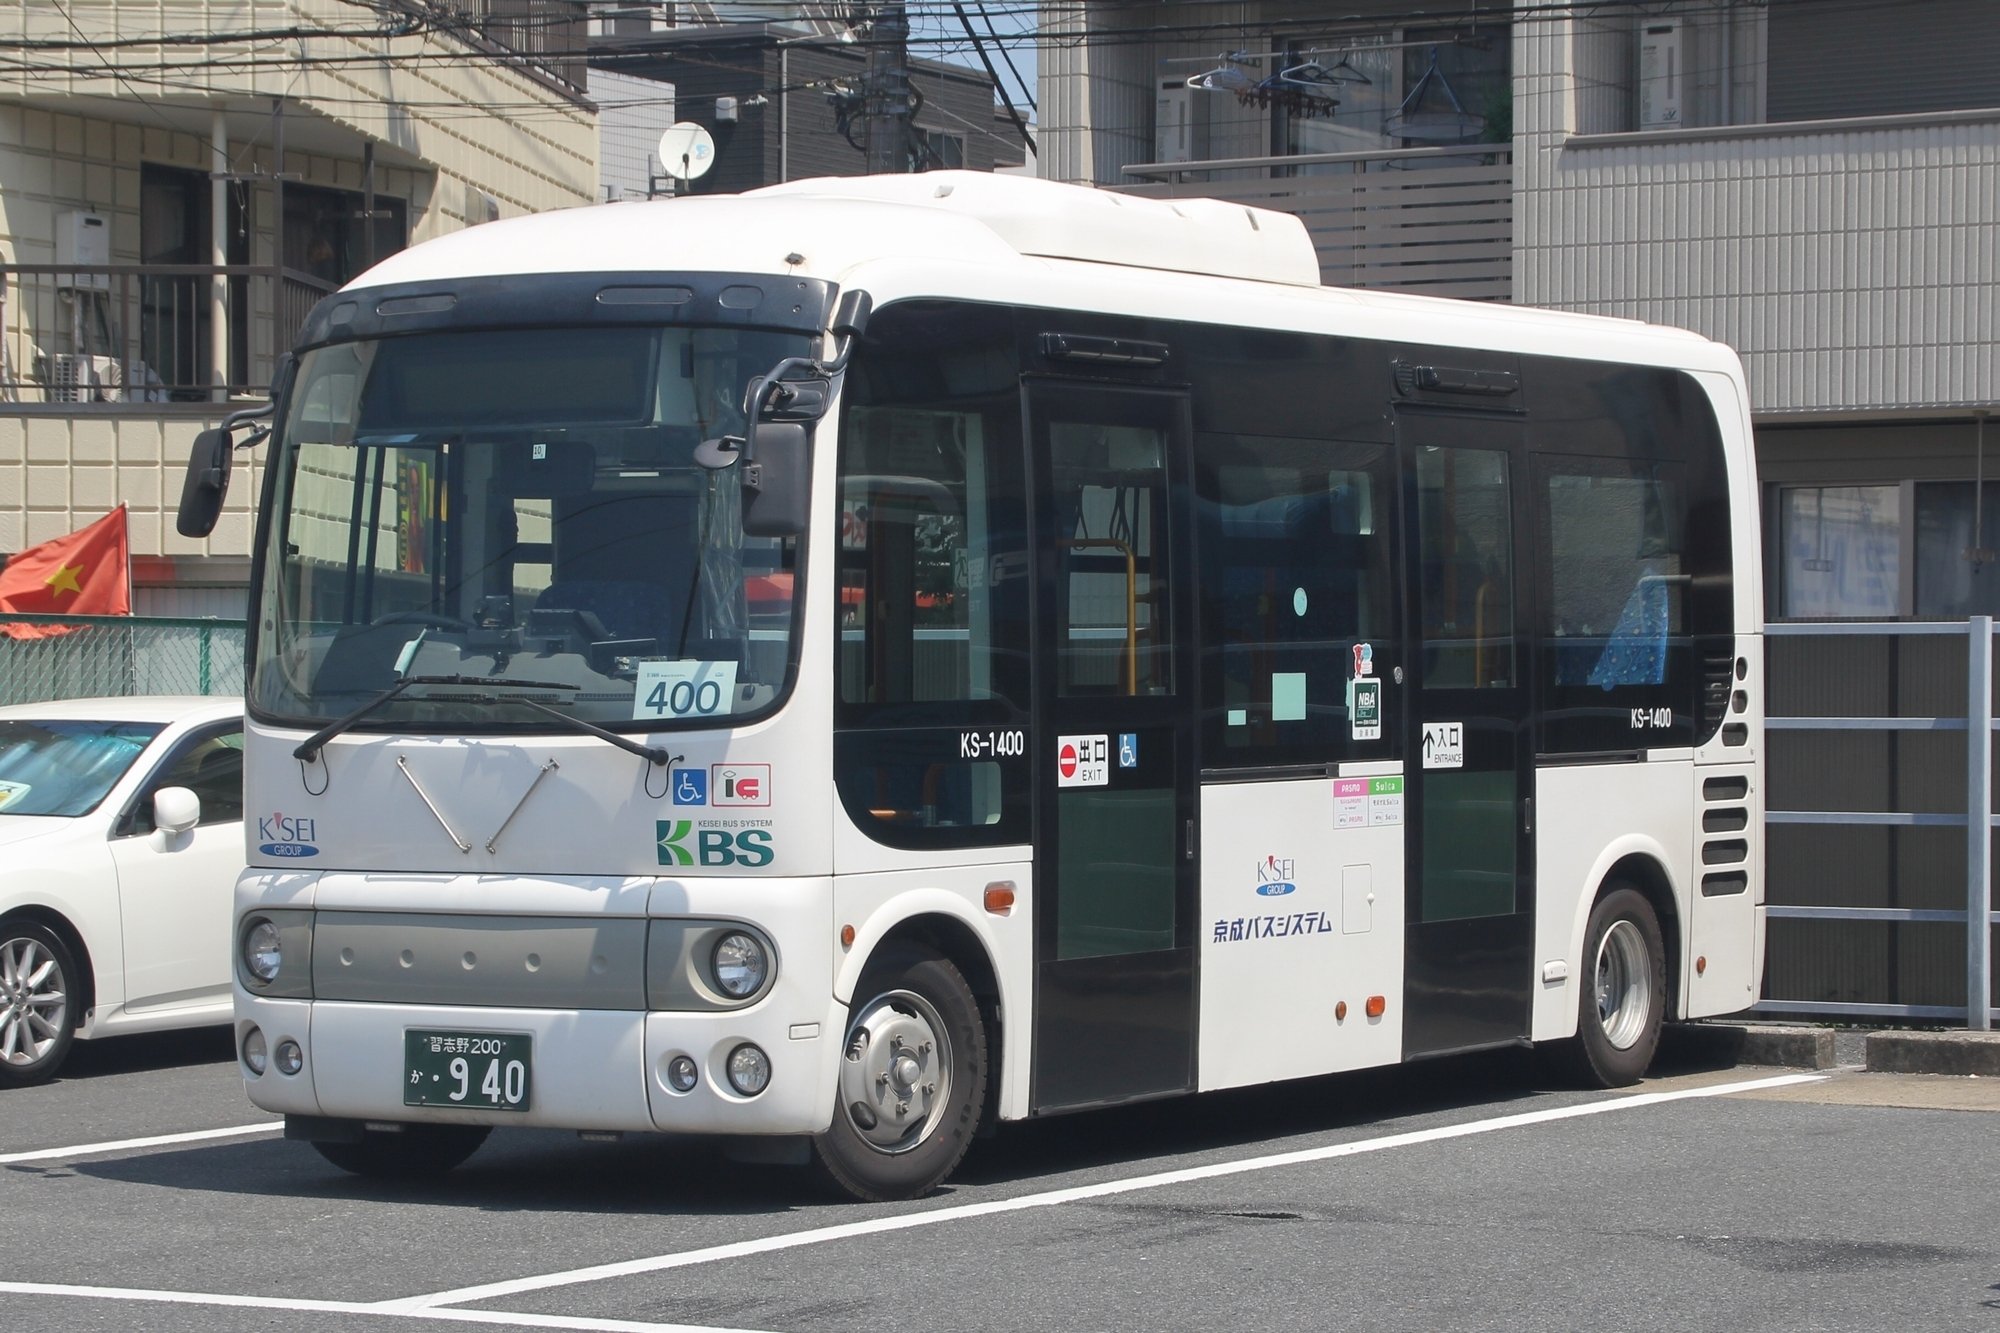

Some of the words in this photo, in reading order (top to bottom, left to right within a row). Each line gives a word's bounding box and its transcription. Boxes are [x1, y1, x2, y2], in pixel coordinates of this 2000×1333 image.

[645, 681, 720, 715] 400
[1358, 692, 1375, 706] NBA
[1631, 707, 1671, 728] KS-1400
[961, 730, 1024, 758] KS-1400
[1437, 727, 1459, 747] 入口
[1079, 739, 1106, 763] 出口
[1434, 753, 1462, 763] ENTRANCE
[1082, 769, 1102, 781] EXIT
[698, 819, 721, 828] KEISEI
[723, 819, 738, 828] BUS
[740, 819, 773, 828] SYSTEM
[273, 845, 302, 856] GROUP
[656, 820, 774, 867] KBS
[1266, 884, 1286, 895] GROUP
[1213, 911, 1332, 943] 京成バスシステム
[410, 1069, 424, 1084] か
